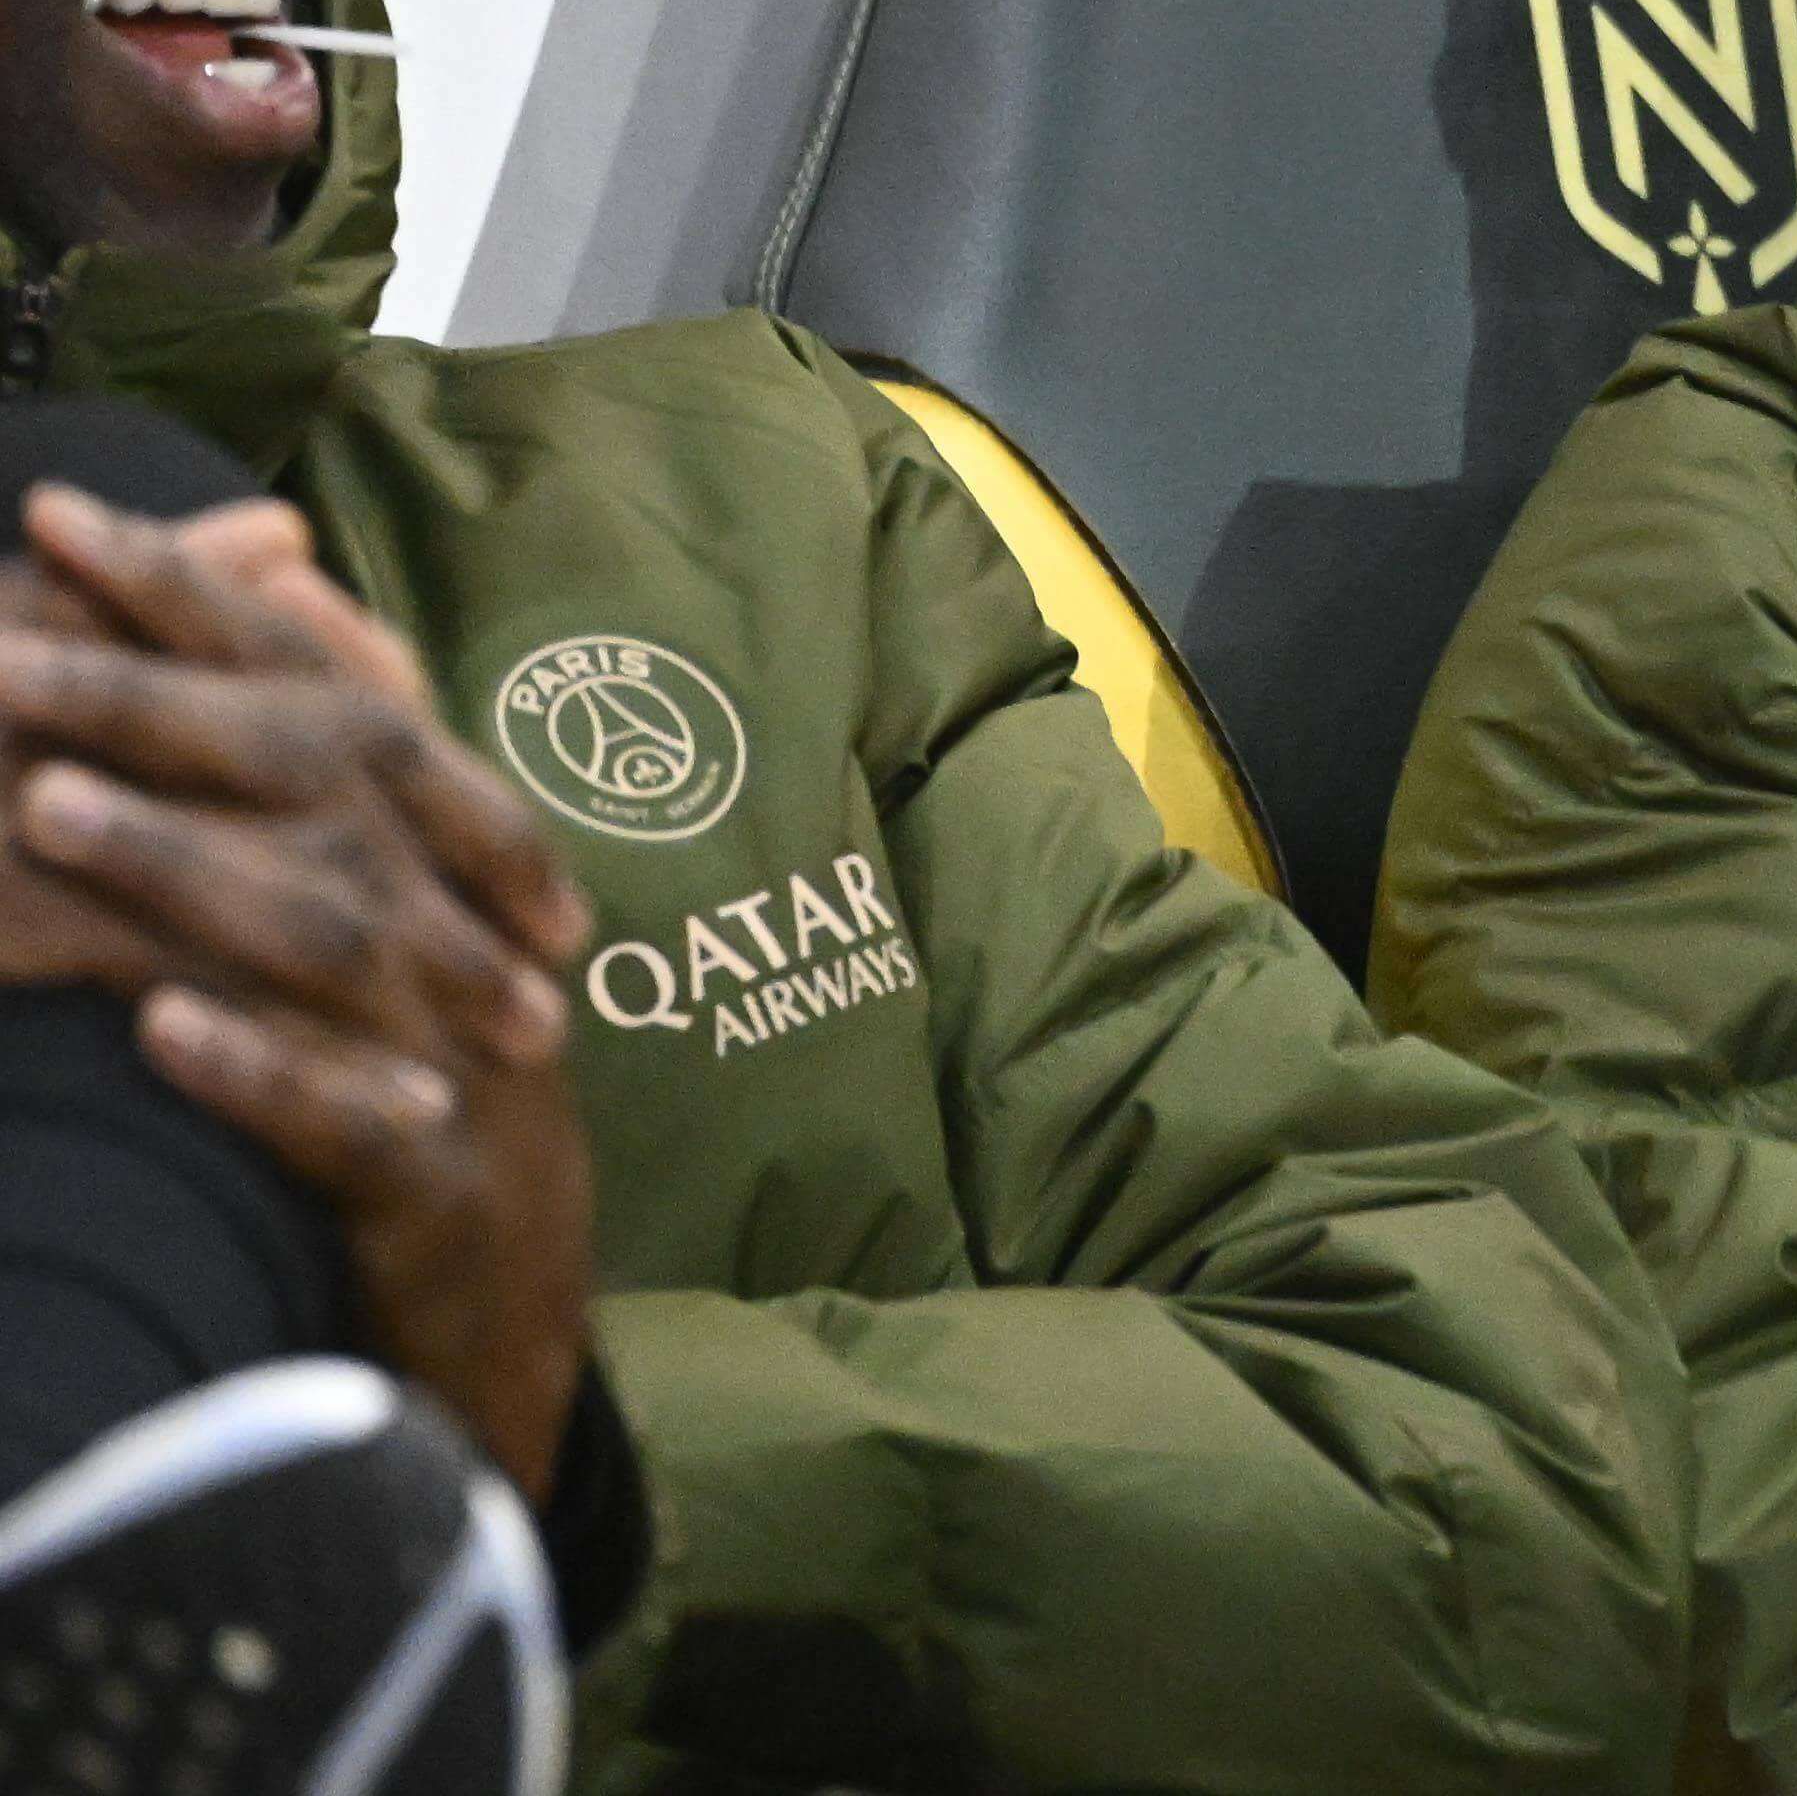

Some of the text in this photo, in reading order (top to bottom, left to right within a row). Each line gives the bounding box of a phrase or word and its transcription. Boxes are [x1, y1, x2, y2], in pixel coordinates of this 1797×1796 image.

[512, 645, 652, 715] PARIS
[587, 852, 896, 1031] QATAR
[714, 938, 918, 1058] AIRWAYS
